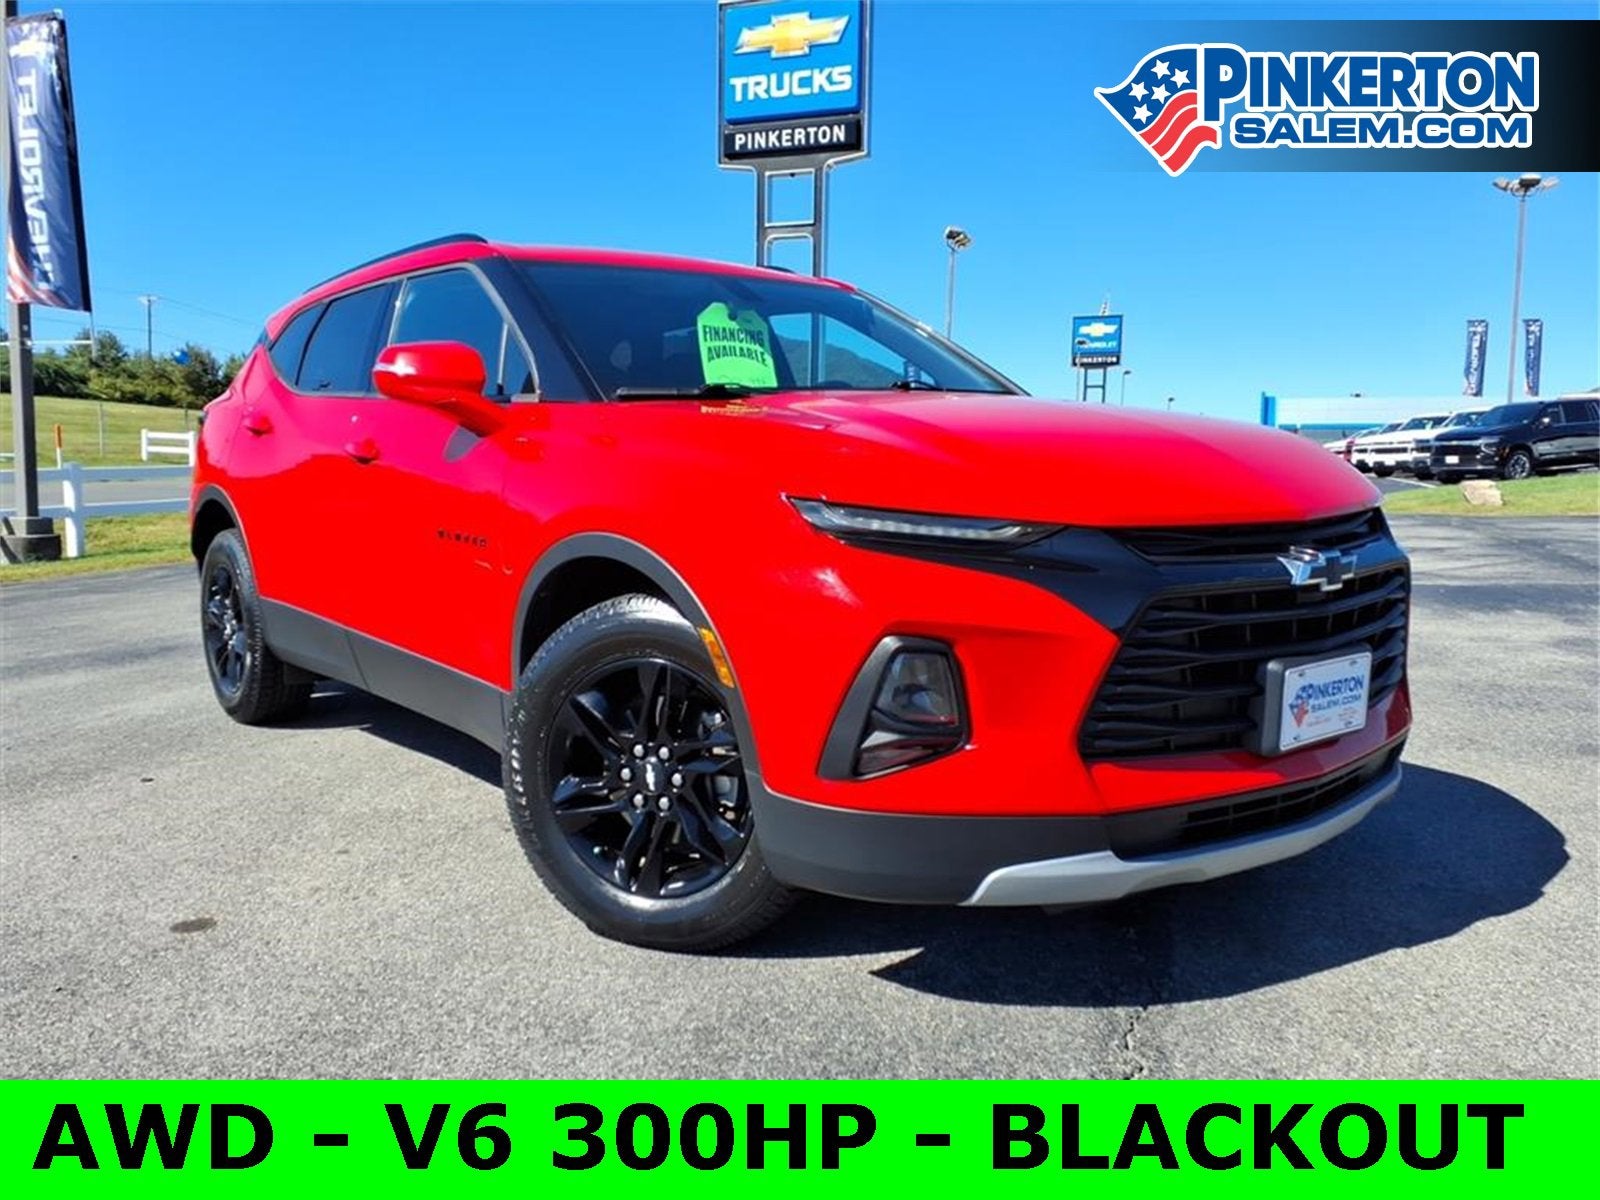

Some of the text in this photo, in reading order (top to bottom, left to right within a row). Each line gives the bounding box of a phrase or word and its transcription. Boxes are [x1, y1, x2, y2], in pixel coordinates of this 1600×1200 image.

[730, 65, 853, 102] TRUCKS
[735, 125, 846, 150] PINKERTON
[702, 325, 765, 349] FINANCING
[707, 345, 768, 367] AVAILABLE
[1306, 675, 1365, 703] PINKERTON
